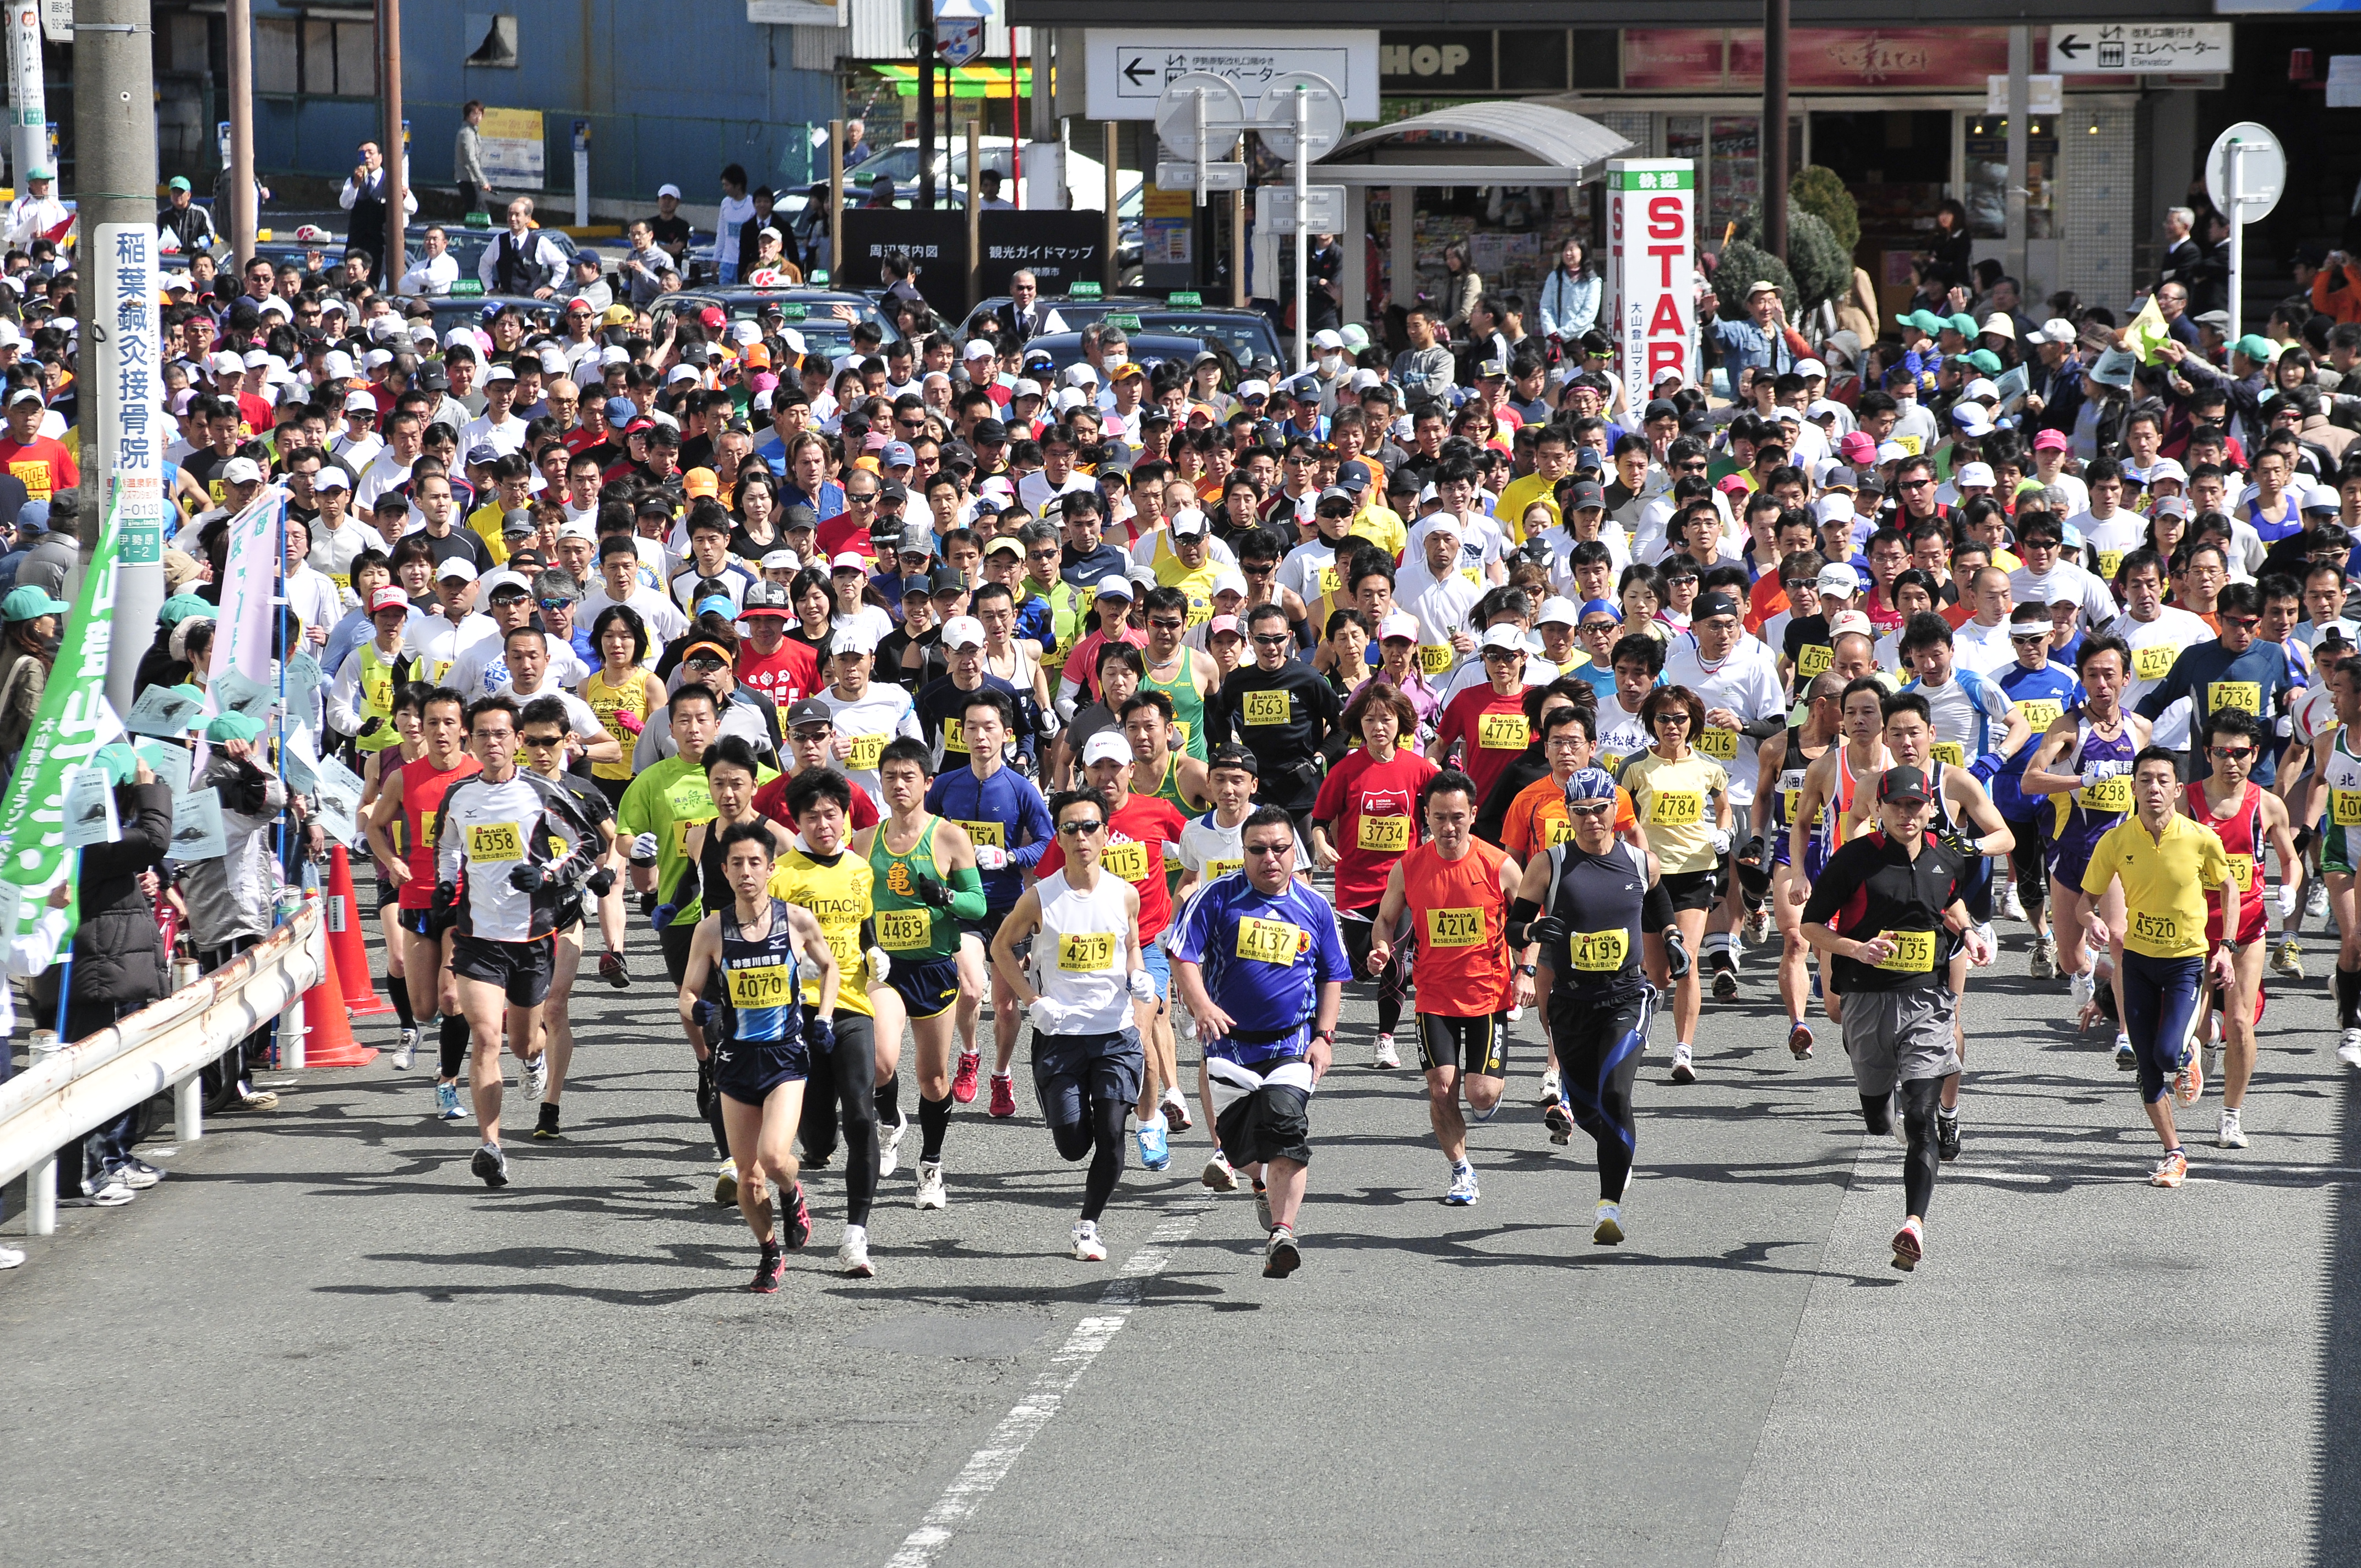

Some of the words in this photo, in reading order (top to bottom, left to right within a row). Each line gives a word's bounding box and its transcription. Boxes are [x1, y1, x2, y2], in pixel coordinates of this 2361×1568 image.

[2131, 41, 2220, 56] エレベーター
[2131, 57, 2173, 67] Elevator
[989, 245, 1094, 260] 観光ガイドマップ
[1647, 196, 1686, 401] STAR
[116, 232, 149, 470] 稲葉鍼灸接骨院
[118, 533, 154, 546] 伊勢原
[123, 546, 150, 558] 1-2
[1420, 651, 1449, 667] 4089
[1804, 655, 1832, 669] 430
[2142, 651, 2174, 671] 4247
[2215, 692, 2253, 707] 4236
[1249, 700, 1283, 716] 4563
[1486, 724, 1523, 740] 4775
[1599, 731, 1659, 747] 浜松健走
[851, 742, 884, 760] 4187
[1695, 736, 1729, 751] 4216
[1784, 776, 1805, 789] 小田
[2087, 785, 2125, 801] 4298
[1657, 799, 1695, 816] 4784
[970, 831, 996, 846] 154
[1366, 826, 1402, 841] 3734
[474, 833, 514, 852] 4358
[883, 921, 923, 939] 4489
[1437, 918, 1477, 935] 4214
[2136, 918, 2175, 938] 4520
[1247, 930, 1291, 951] 4137
[1067, 943, 1107, 961] 4219
[1579, 941, 1622, 962] 4199
[732, 955, 781, 968] 神奈川県警
[737, 977, 781, 998] 4070
[1416, 1025, 1427, 1062] SKINS
[1492, 1023, 1503, 1059] SKINS
